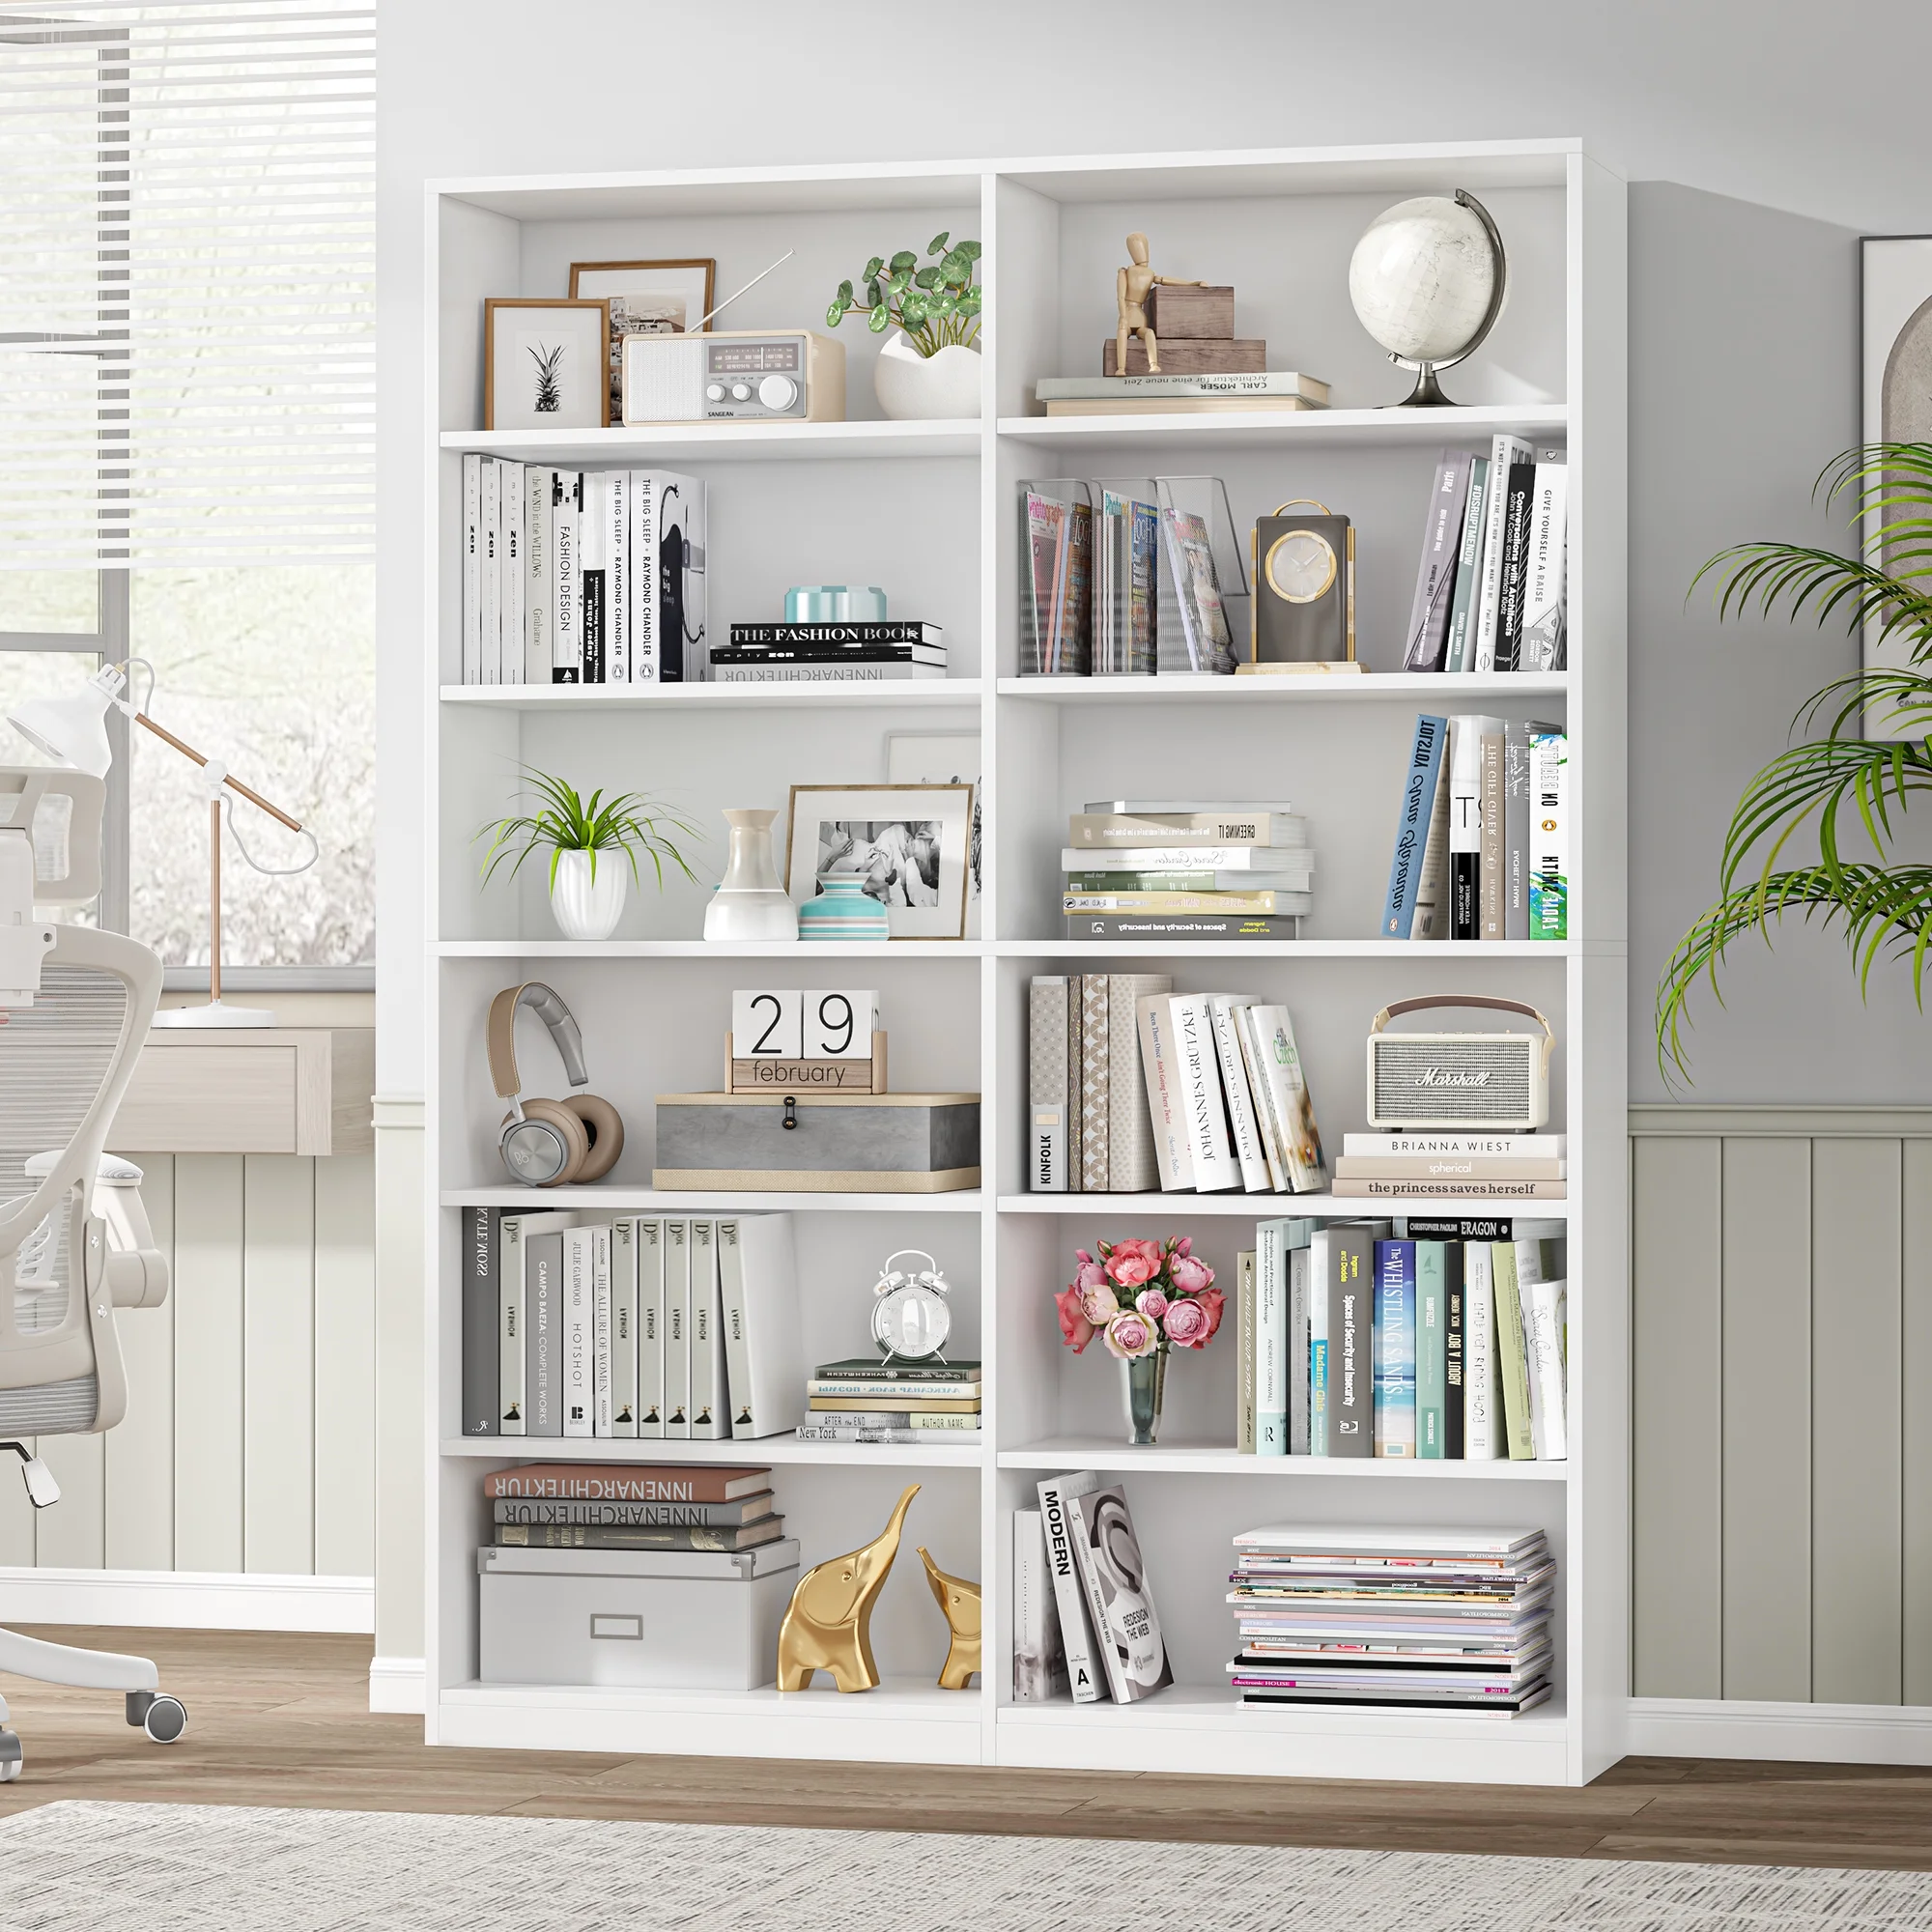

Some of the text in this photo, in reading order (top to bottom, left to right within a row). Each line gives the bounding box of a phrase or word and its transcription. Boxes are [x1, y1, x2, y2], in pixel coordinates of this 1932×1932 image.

[1441, 470, 1455, 493] Paris
[1543, 489, 1552, 511] GIVE
[1464, 484, 1483, 567] #DISRUPTMENOW
[1538, 515, 1550, 562] YOURSELF
[1505, 491, 1525, 637] Conversations with Architects
[560, 526, 571, 631] FASHION DESIGN
[643, 556, 651, 604] RAYMOND
[1535, 574, 1545, 602] RAISE
[533, 608, 543, 646] Grahame
[643, 608, 651, 655] CHANDLER
[731, 627, 919, 641] THE FASHION BOOK
[725, 668, 882, 682] INNENARCHITEKTUR
[752, 1060, 846, 1087] february
[1181, 1007, 1217, 1161] JOHANNES GRÜTZKE
[1415, 1067, 1491, 1086] Marshall
[1040, 1135, 1051, 1185] KINFOLK
[1392, 1142, 1511, 1151] BRIANNA WIEST
[1429, 1162, 1472, 1175] spherical
[1368, 1183, 1536, 1195] the princess saves herself
[1409, 1222, 1458, 1232] CHRISTOPHER PAOLINI
[1461, 1222, 1497, 1236] ERAGON
[1350, 1255, 1359, 1278] Ingram
[1391, 1248, 1401, 1260] The
[573, 1242, 582, 1306] JULIE GARWOOD
[1342, 1295, 1356, 1319] Spaces
[1383, 1260, 1403, 1343] WHISTLING
[1426, 1296, 1435, 1328] BUMFUZZLE
[1451, 1294, 1460, 1327] NICK HORNBY
[539, 1261, 547, 1425] CAMPO BAEZA: COMPLETE WORKS
[598, 1273, 608, 1392] THE ALLURE OF WOMEN
[1342, 1328, 1355, 1357] Security
[1448, 1332, 1462, 1348] BOY
[1530, 1309, 1551, 1374] Secret Garden
[572, 1323, 582, 1388] HOTSHOT
[1344, 1358, 1354, 1371] and
[1315, 1345, 1325, 1412] Madame Ghis
[1383, 1348, 1403, 1394] SANDS
[1448, 1361, 1462, 1385] ABOUT
[1342, 1371, 1354, 1406] Insecurity
[799, 1427, 837, 1439] New York
[922, 1419, 964, 1428] AUTHOR NAME
[495, 1477, 693, 1501] INNENARCHITEKTUR
[504, 1504, 709, 1527] INNENARCHITEKTUR
[1045, 1491, 1071, 1576] MODERN
[1093, 1589, 1112, 1644] REDESIGN THE WEB
[1122, 1607, 1150, 1628] REDESIGN
[1126, 1623, 1150, 1642] THE WEB
[1077, 1668, 1090, 1685] A
